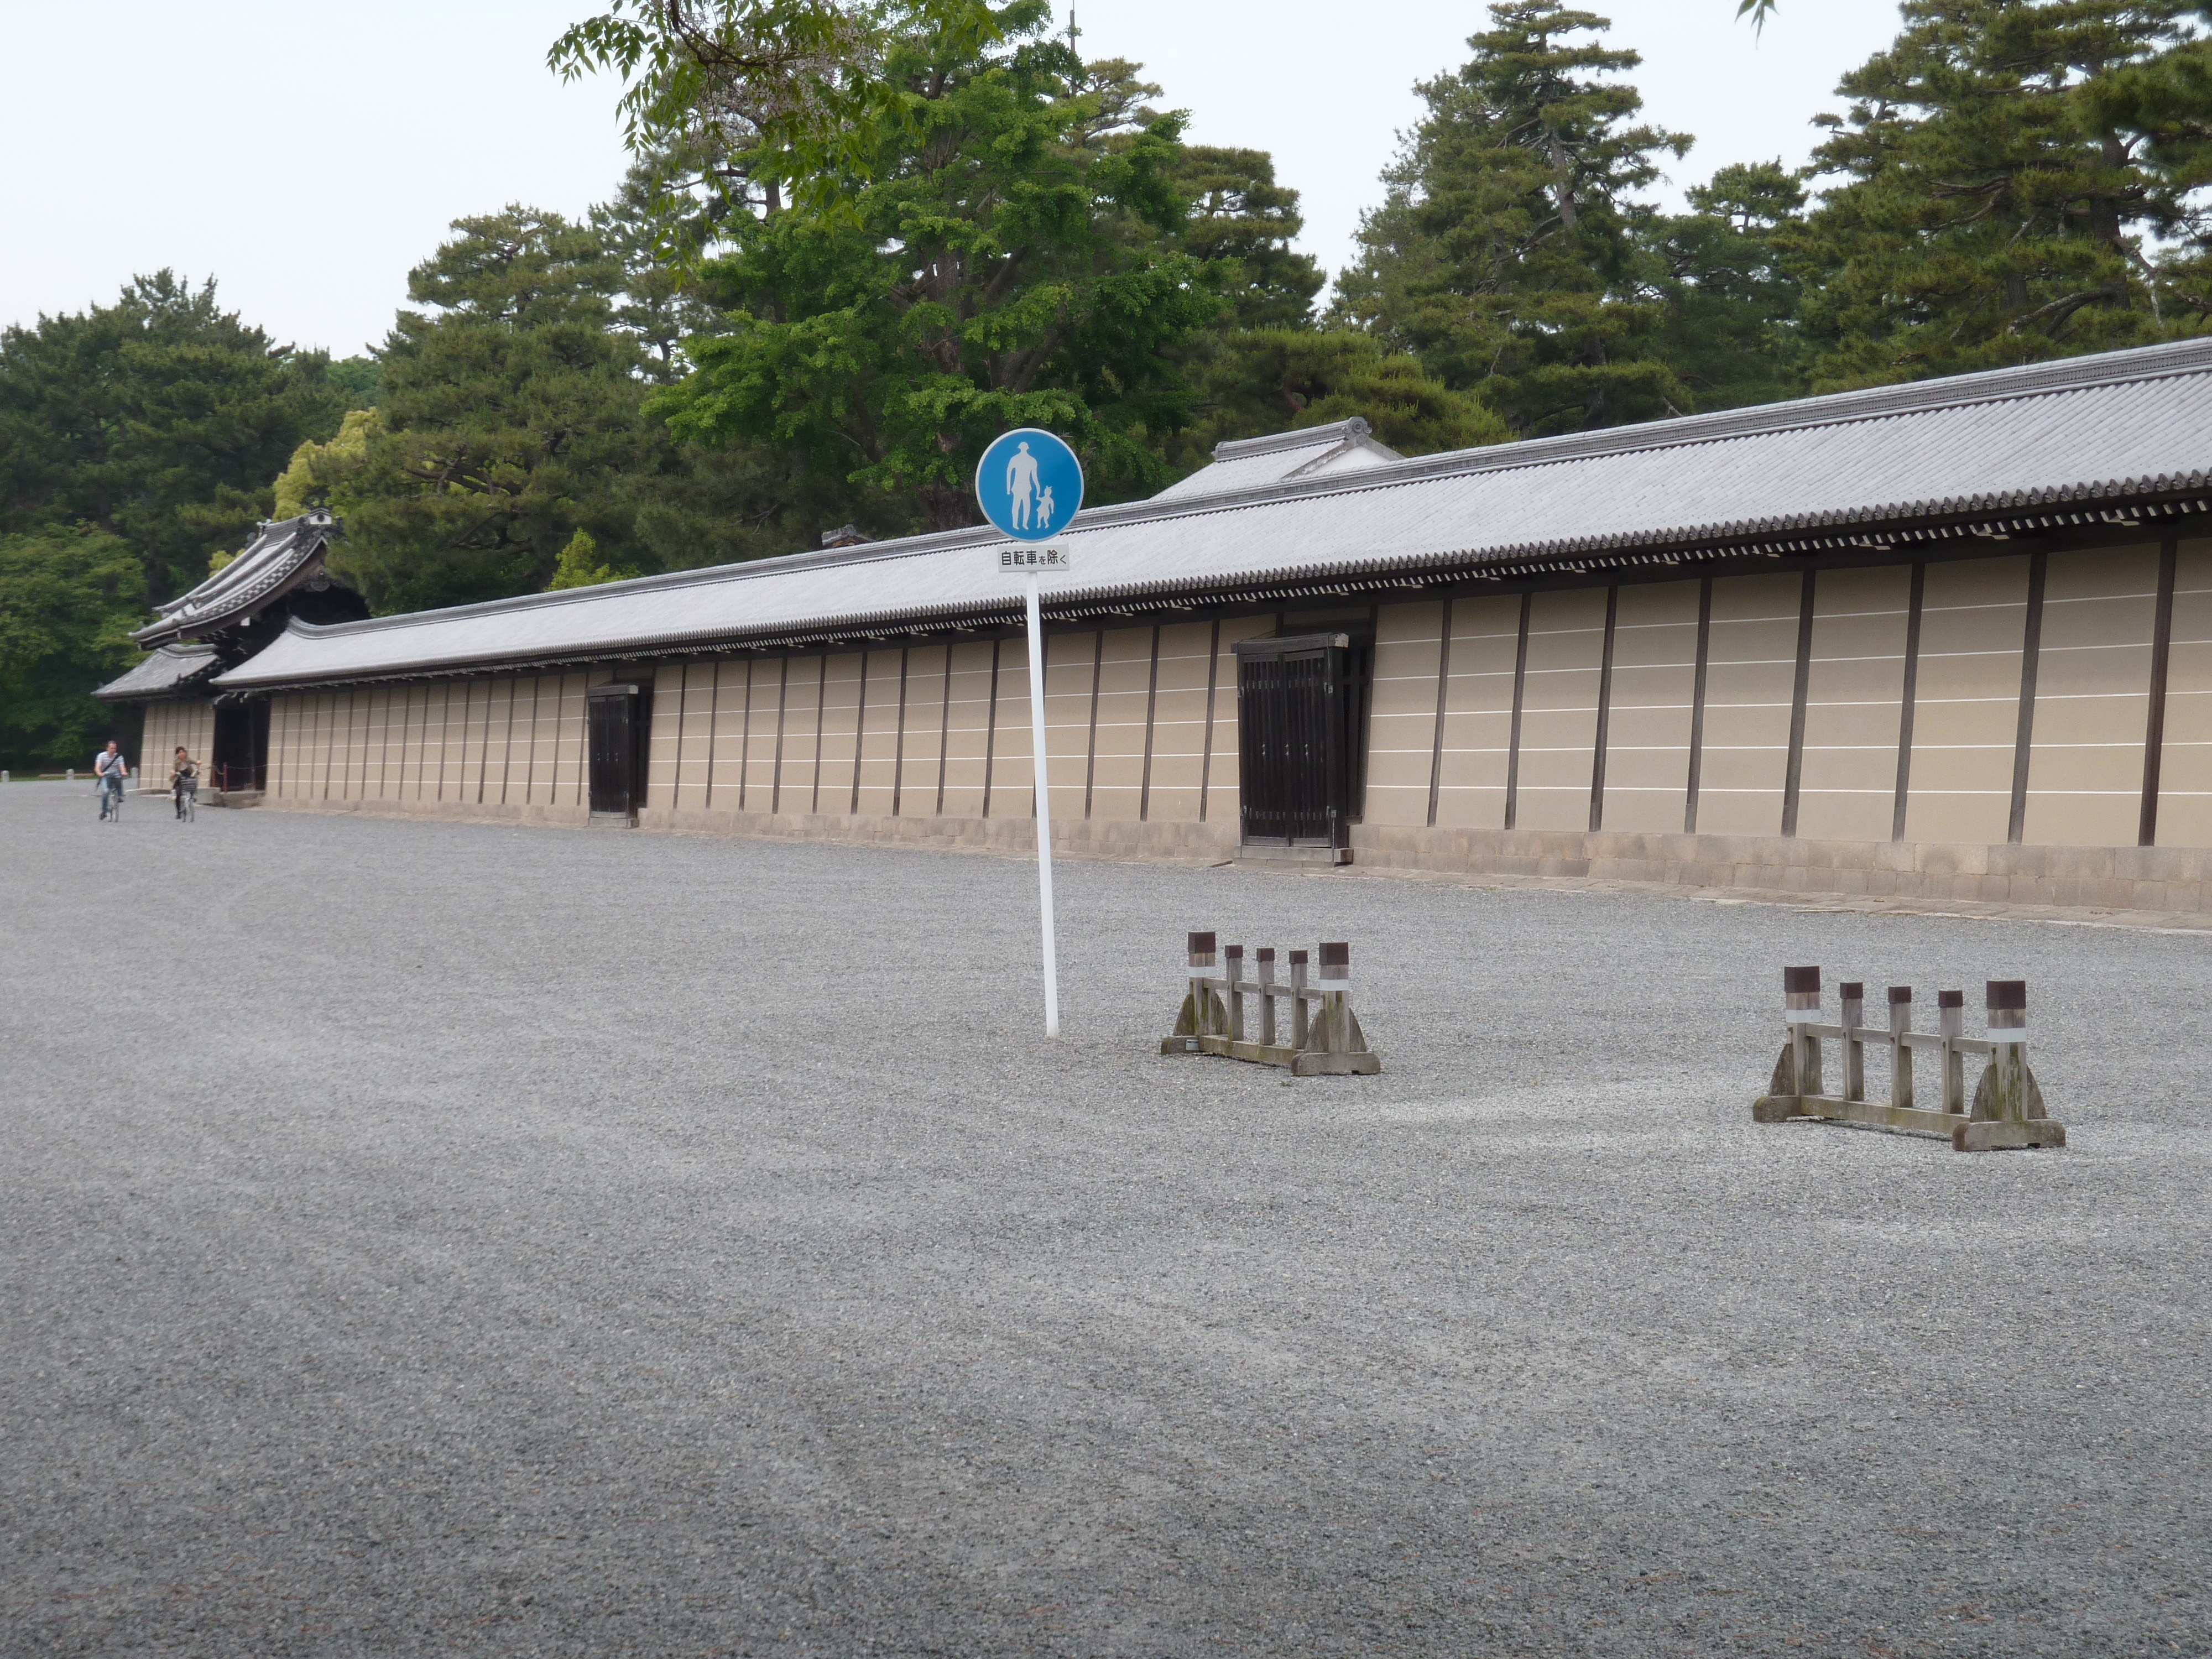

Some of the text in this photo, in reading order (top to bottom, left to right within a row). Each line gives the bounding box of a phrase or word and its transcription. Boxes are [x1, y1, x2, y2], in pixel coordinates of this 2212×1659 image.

[1001, 550, 1067, 565] 自転車を除く
